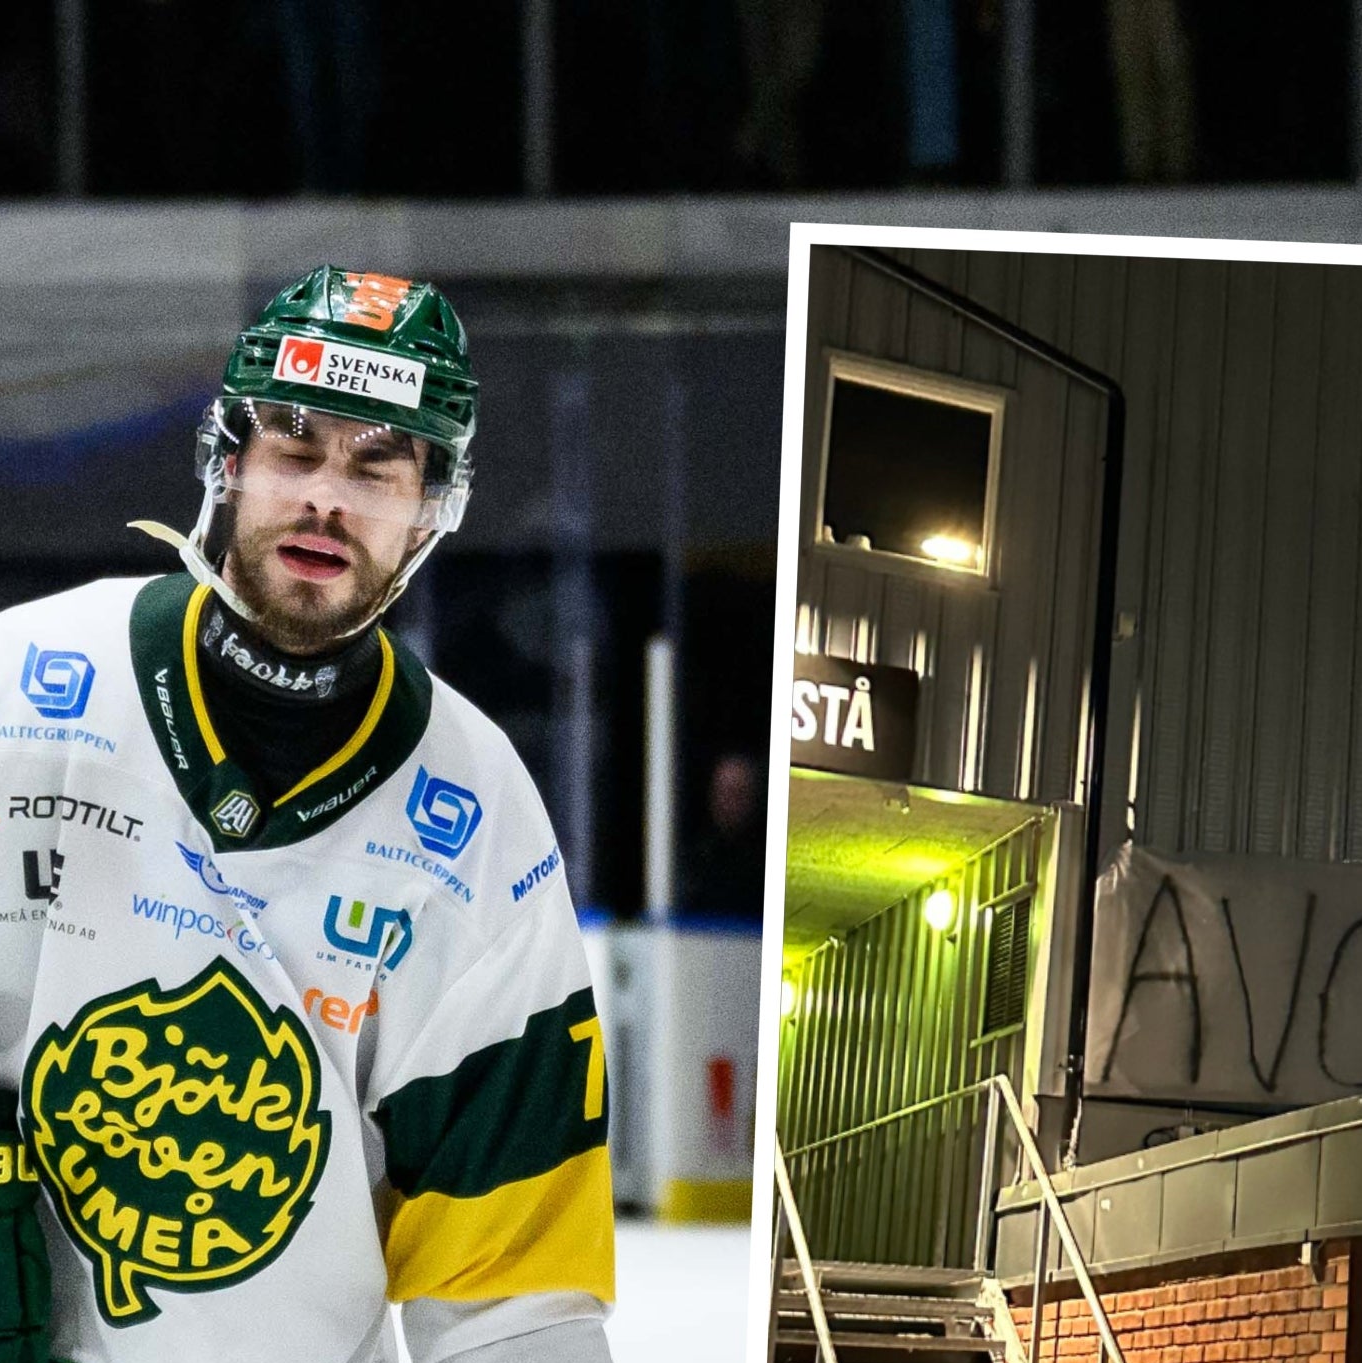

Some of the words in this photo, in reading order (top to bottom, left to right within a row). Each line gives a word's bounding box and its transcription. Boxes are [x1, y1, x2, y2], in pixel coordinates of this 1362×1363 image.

[324, 371, 372, 395] SPEL
[327, 353, 418, 388] SVENSKA
[79, 927, 97, 941] AB
[59, 1145, 253, 1267] UMEÅ
